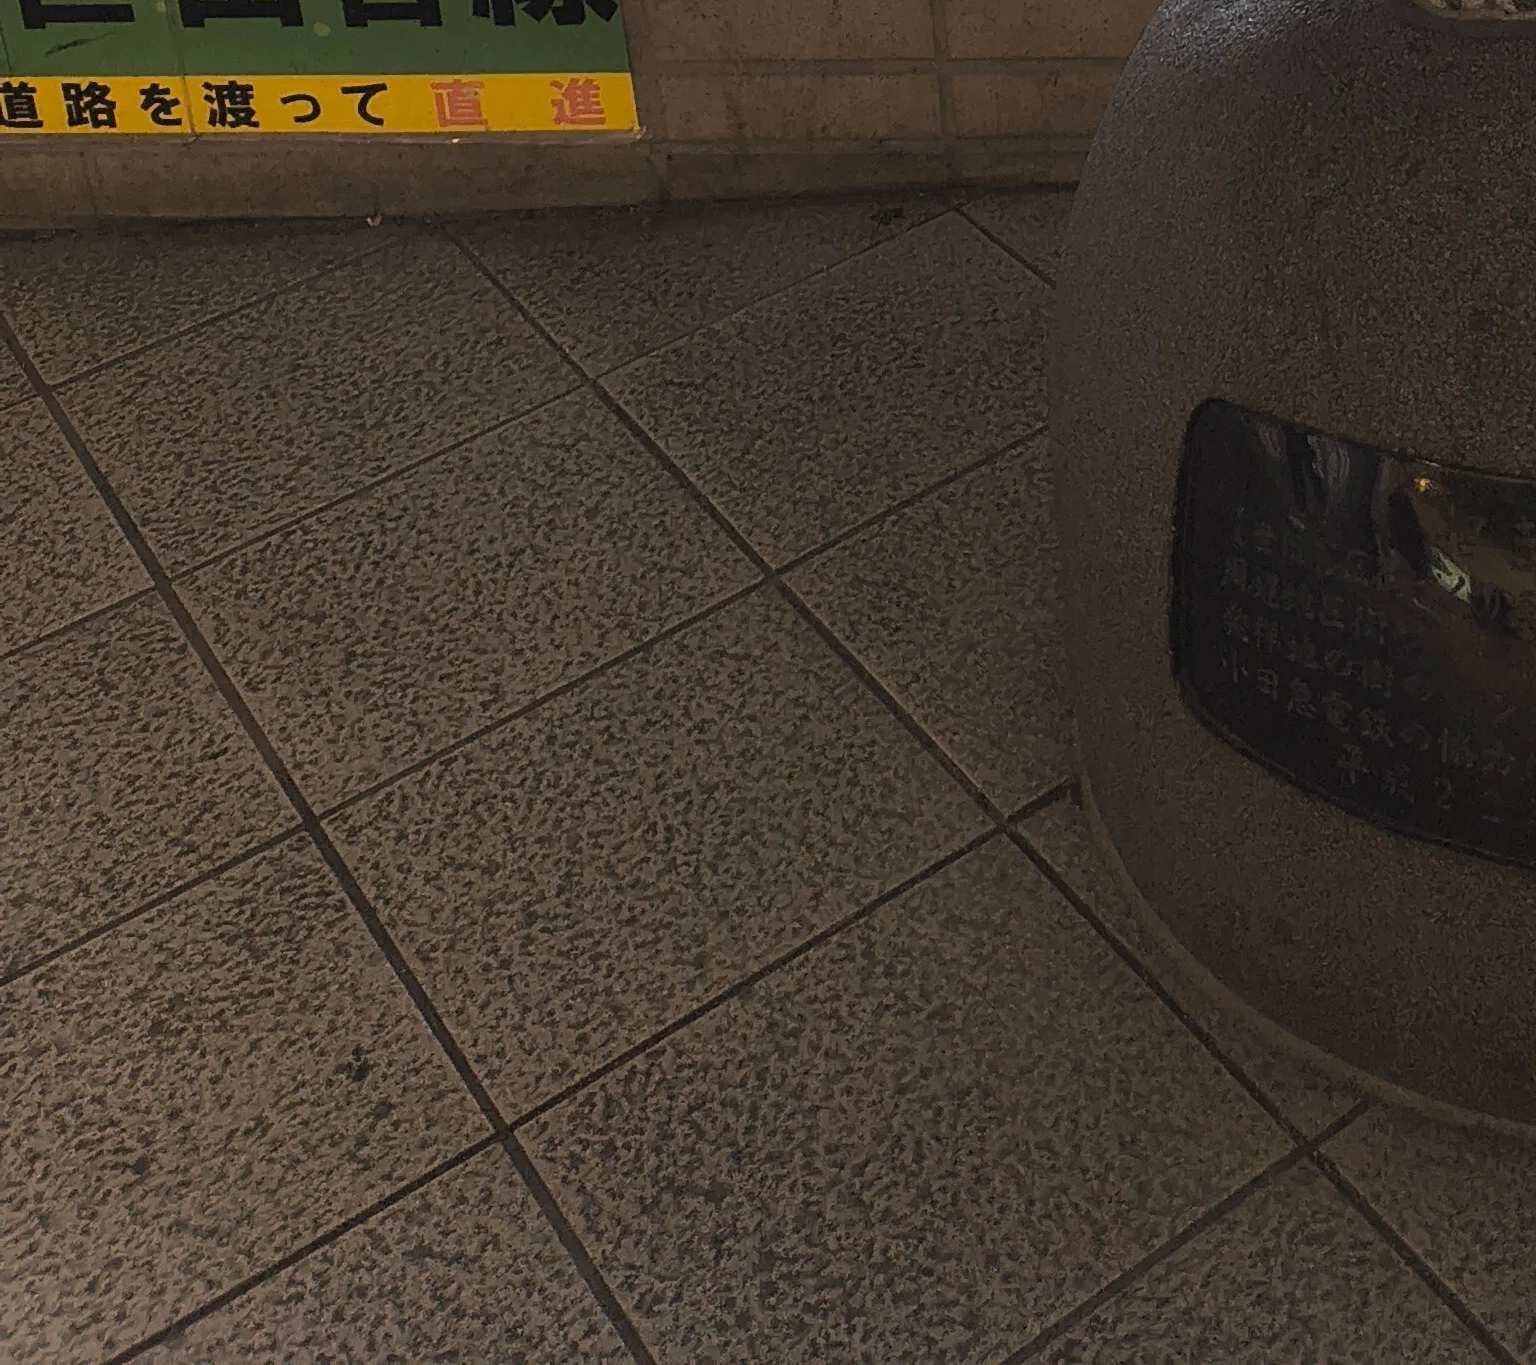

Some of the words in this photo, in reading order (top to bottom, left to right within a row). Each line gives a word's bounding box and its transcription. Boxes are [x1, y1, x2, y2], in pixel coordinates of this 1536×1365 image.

[0, 80, 389, 129] 道路を渡って
[429, 76, 607, 128] 直進
